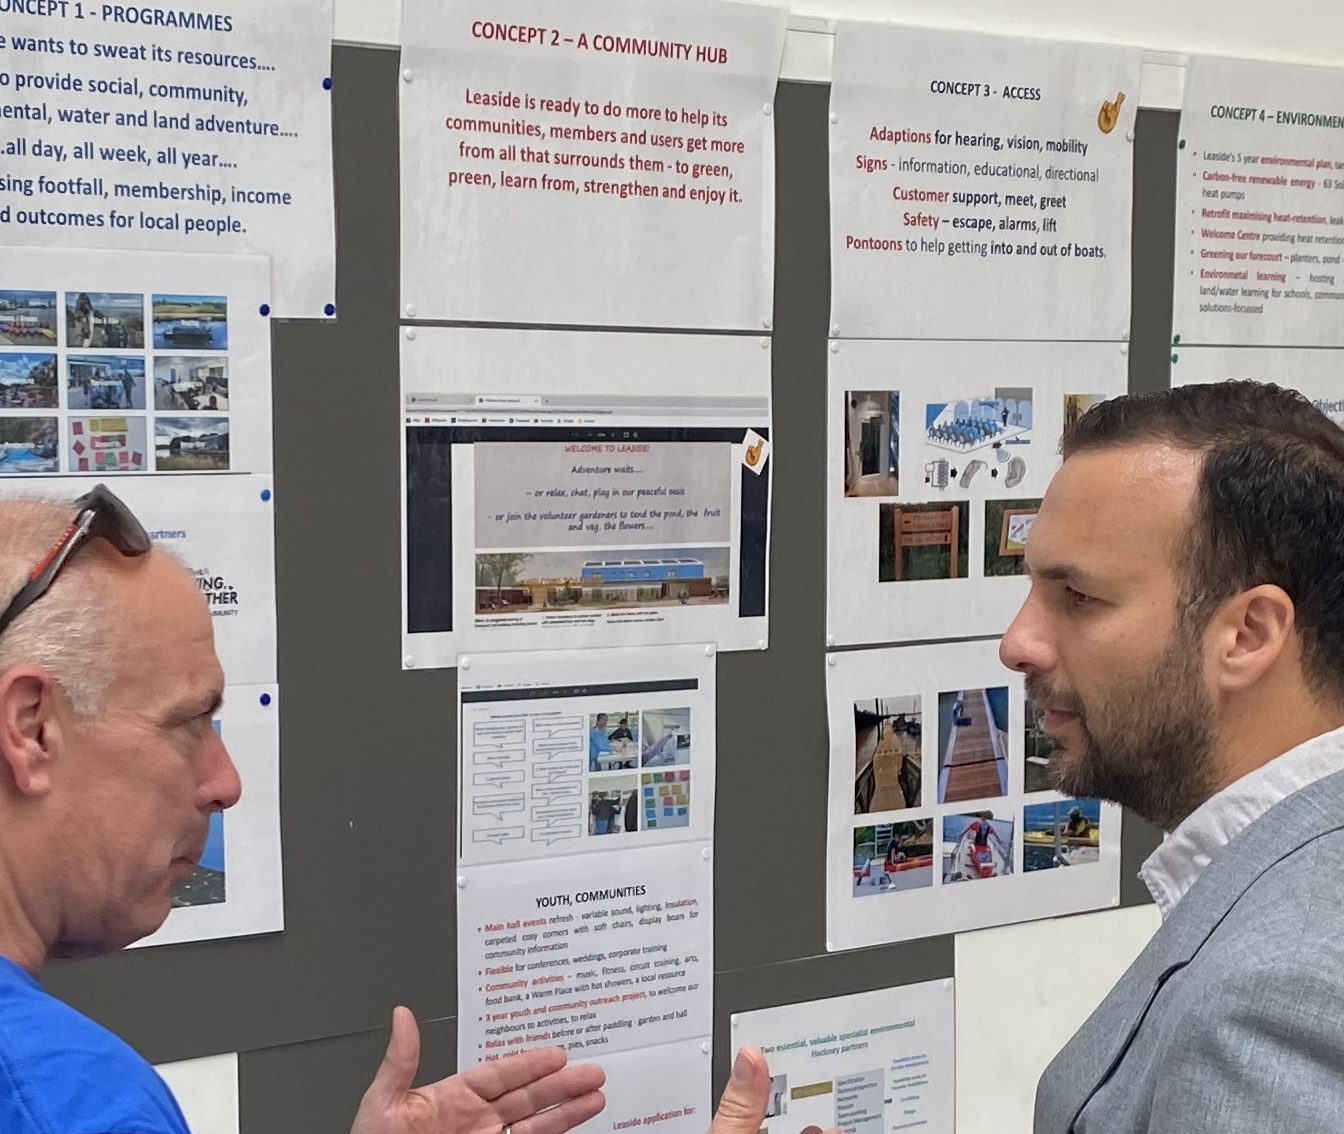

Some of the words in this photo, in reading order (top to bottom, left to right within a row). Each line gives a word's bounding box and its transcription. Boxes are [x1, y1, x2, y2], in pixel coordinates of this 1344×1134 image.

[74, 2, 84, 19] 1
[102, 4, 232, 32] PROGRAMMES
[10, 36, 64, 54] wants
[68, 38, 88, 56] to
[93, 43, 147, 60] sweat
[151, 43, 172, 62] its
[471, 20, 547, 44] CONCEPT
[550, 29, 559, 46] 2
[576, 32, 588, 50] A
[592, 34, 692, 60] COMMUNITY
[695, 45, 727, 64] HUB
[15, 72, 82, 92] provide
[87, 76, 143, 99] social,
[148, 83, 248, 107] community,
[930, 79, 981, 96] CONCEPT
[983, 84, 990, 97] 3
[1001, 85, 1041, 101] ACCESS
[57, 107, 110, 125] water
[115, 109, 148, 127] and
[153, 109, 190, 130] land
[465, 87, 520, 108] Leaside
[524, 93, 536, 110] is
[539, 96, 581, 117] ready
[583, 99, 599, 115] to
[602, 100, 622, 117] do
[625, 106, 662, 121] more
[664, 107, 678, 122] to
[681, 107, 709, 128] help
[712, 110, 728, 127] its
[1210, 104, 1258, 122] CONCEPT
[1258, 109, 1265, 122] 4
[445, 117, 545, 140] communities,
[549, 124, 617, 143] members
[620, 128, 647, 145] and
[650, 134, 683, 148] users
[686, 136, 707, 153] get
[710, 139, 744, 153] more
[869, 125, 932, 145] Adaptions
[934, 129, 953, 145] for
[954, 130, 1004, 151] hearing,
[1006, 133, 1043, 153] vision,
[1045, 137, 1088, 157] mobility
[31, 138, 67, 162] day,
[73, 141, 94, 159] all
[99, 144, 151, 167] week,
[156, 146, 176, 165] all
[458, 140, 495, 160] from
[498, 144, 516, 161] all
[519, 146, 550, 164] that
[553, 152, 625, 169] surrounds
[628, 154, 664, 172] them
[675, 159, 689, 174] to
[691, 163, 733, 180] green,
[855, 154, 888, 173] Signs
[898, 156, 970, 178] information,
[973, 160, 1042, 181] educational,
[1044, 164, 1099, 183] directional
[37, 175, 108, 199] footfall,
[113, 181, 226, 205] membership,
[231, 185, 291, 205] income
[448, 171, 496, 189] preen,
[500, 170, 537, 189] learn
[541, 173, 579, 195] from,
[583, 178, 658, 199] strengthen
[662, 183, 686, 199] and
[689, 185, 726, 205] enjoy
[728, 187, 743, 203] it.
[892, 185, 950, 203] Customer
[951, 191, 1002, 207] support,
[1004, 193, 1037, 209] meet,
[1039, 195, 1066, 211] greet
[15, 208, 104, 227] outcomes
[108, 209, 135, 228] for
[139, 210, 179, 230] local
[184, 214, 246, 236] people.
[902, 211, 939, 230] Safety
[952, 217, 996, 232] escape,
[998, 215, 1040, 234] alarms,
[1042, 217, 1057, 232] lift
[846, 235, 903, 251] Pontoons
[905, 238, 918, 252] to
[920, 236, 945, 256] help
[947, 239, 988, 258] getting
[990, 239, 1013, 255] into
[1015, 240, 1037, 255] and
[1039, 243, 1058, 257] out
[1059, 242, 1072, 257] of
[1074, 242, 1107, 258] boats.
[148, 529, 187, 540] artners
[535, 894, 573, 909] YOUTH,
[574, 884, 646, 903] COMMUNITIES
